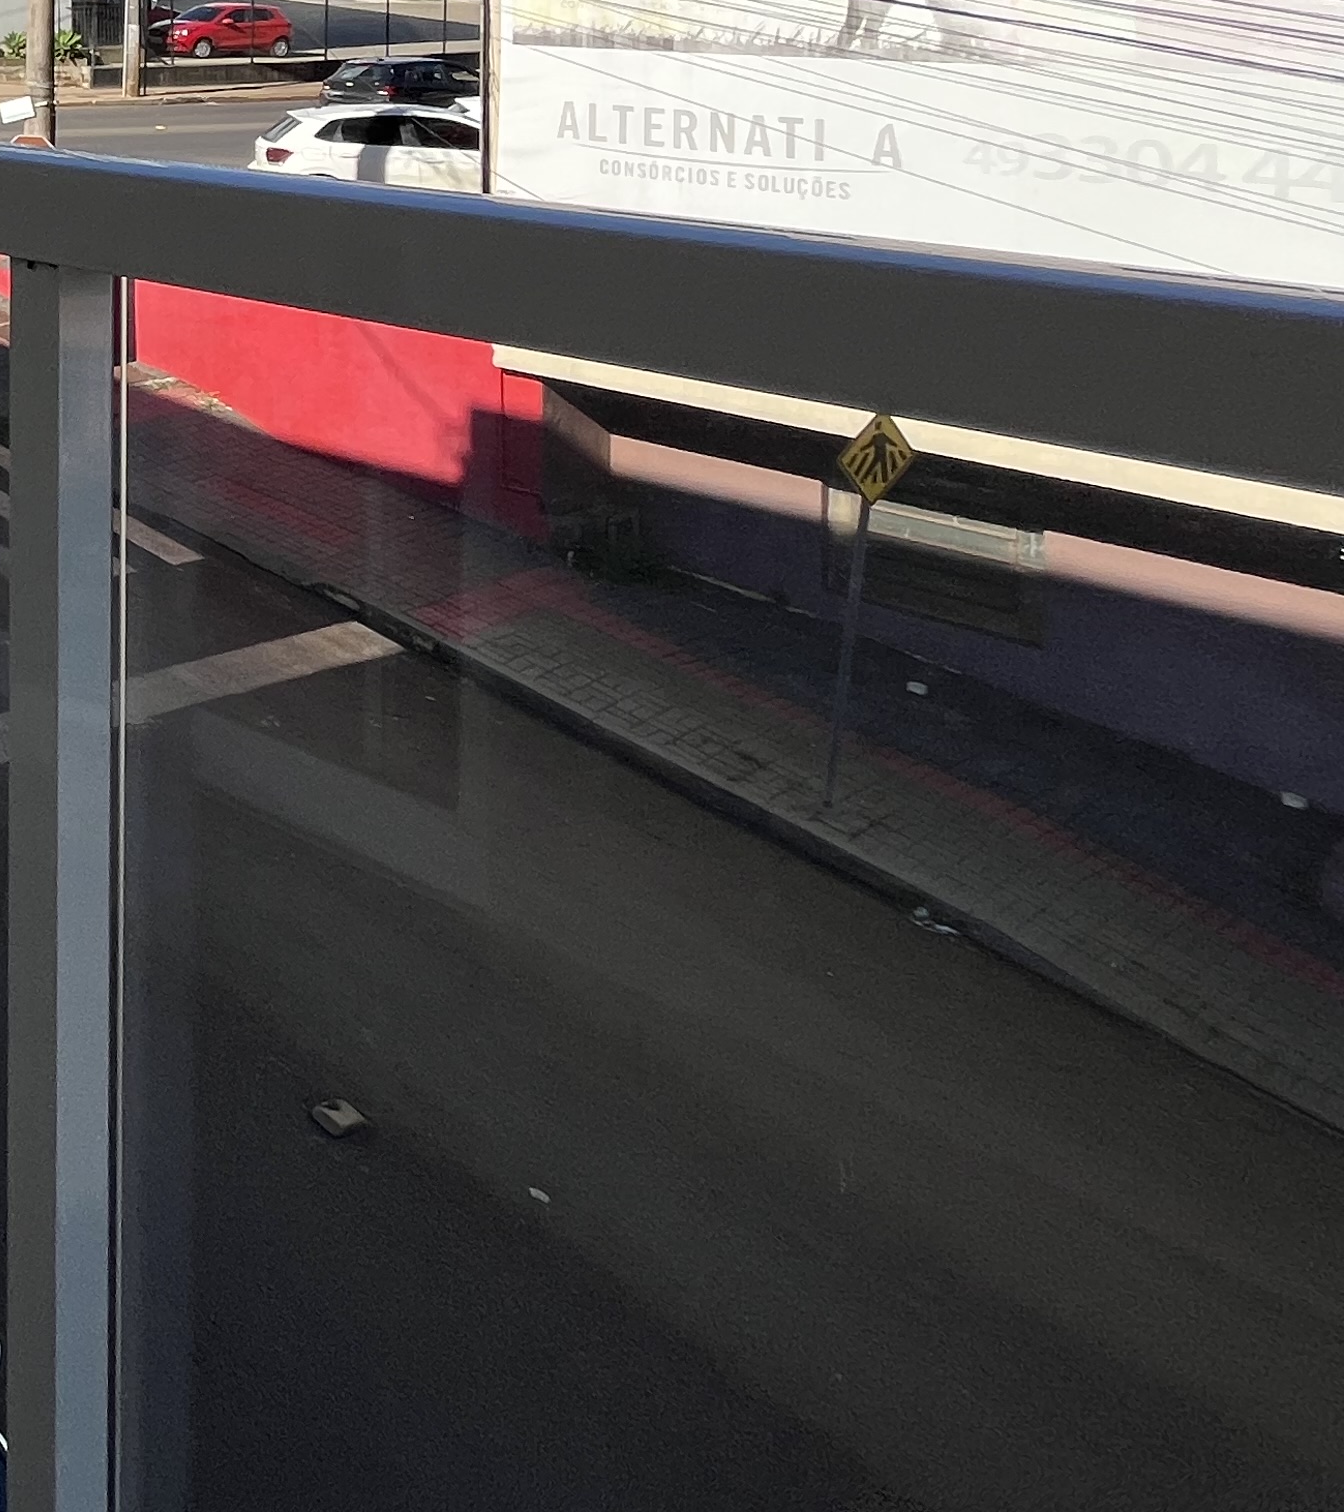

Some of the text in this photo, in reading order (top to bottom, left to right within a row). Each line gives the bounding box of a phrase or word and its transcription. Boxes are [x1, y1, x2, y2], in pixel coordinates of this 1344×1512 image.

[556, 100, 904, 168] ALTERNATIA
[599, 158, 852, 200] CONSÓRCIOS E SOLUÇÕES
